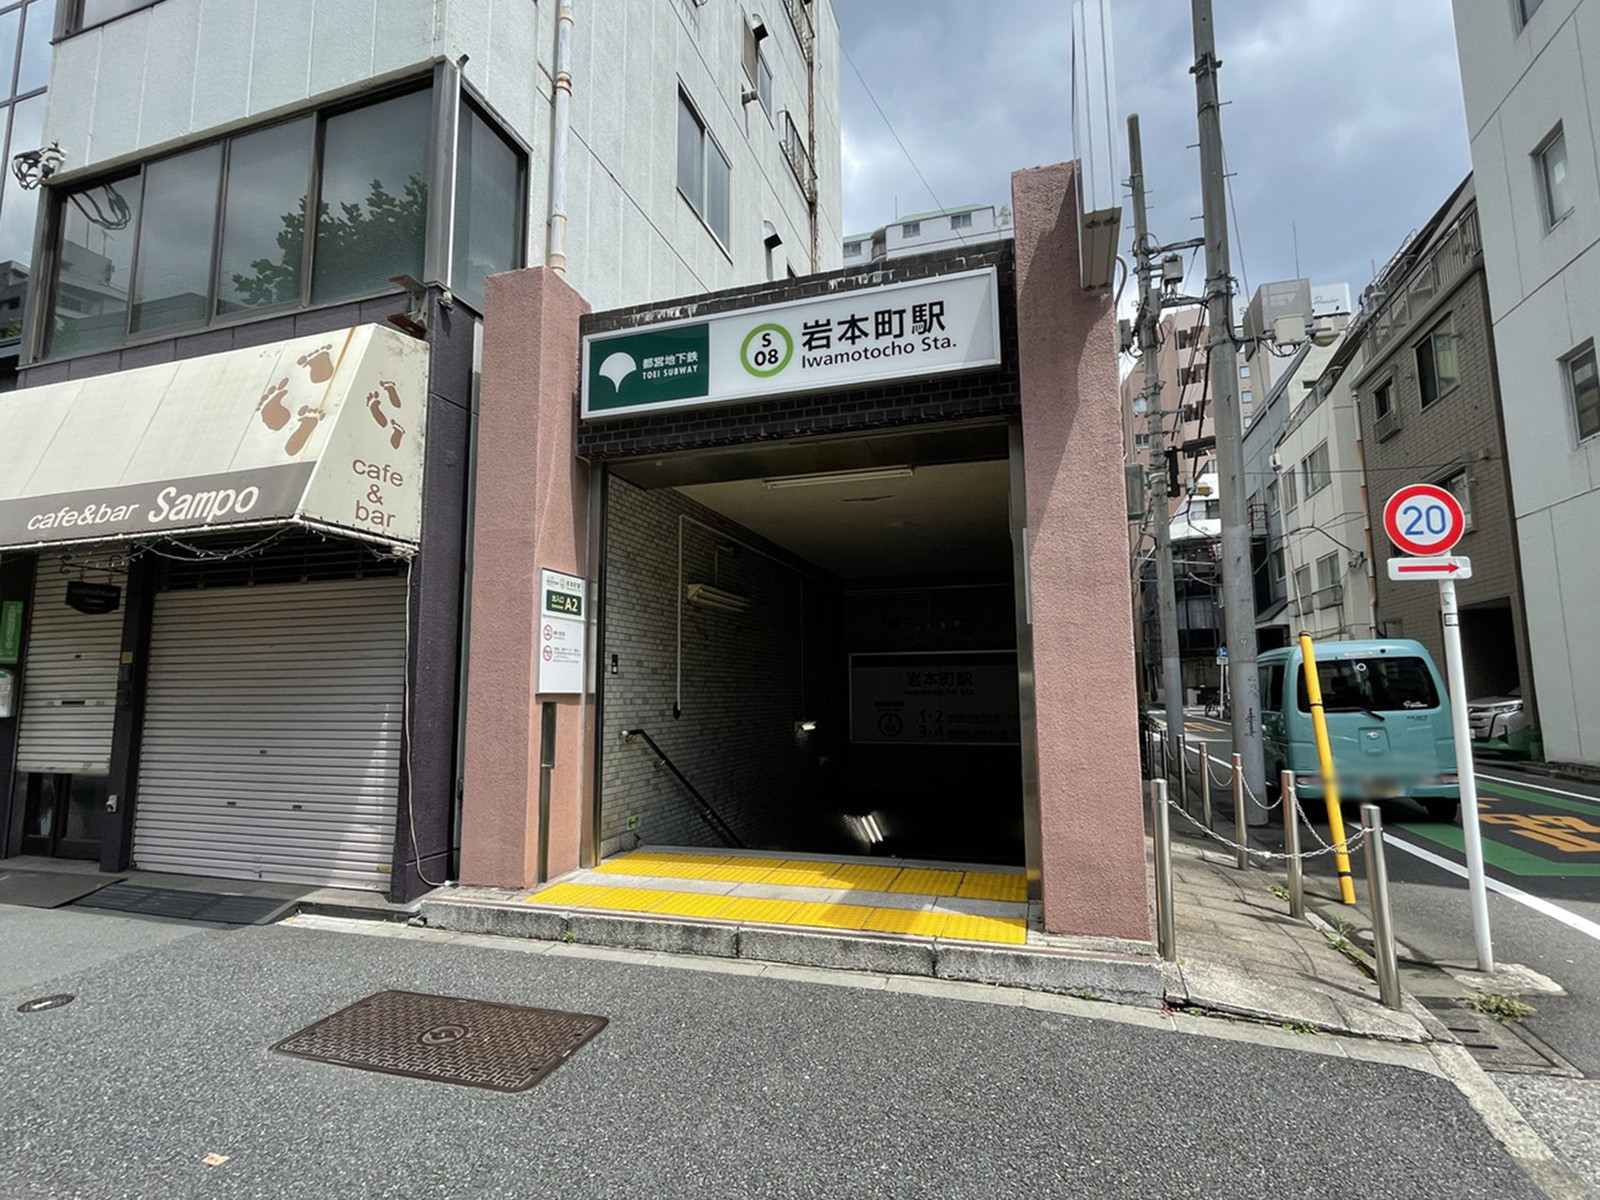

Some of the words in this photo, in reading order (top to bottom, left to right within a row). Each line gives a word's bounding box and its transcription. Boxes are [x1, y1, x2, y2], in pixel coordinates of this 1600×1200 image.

[801, 300, 946, 352] 岩本町駅
[762, 332, 772, 348] S
[802, 341, 915, 369] Iwamotocho
[922, 336, 957, 352] Sta.
[643, 351, 698, 369] 都営地下鉄
[754, 349, 779, 367] 08
[643, 370, 660, 380] TOEI
[663, 364, 698, 377] SUBWAY
[352, 459, 403, 487] cafe
[366, 483, 383, 505] &
[27, 503, 140, 531] cafe&bar
[148, 486, 259, 522] Sampo
[355, 499, 396, 527] bar
[1403, 505, 1446, 535] 20
[565, 597, 578, 612] A2
